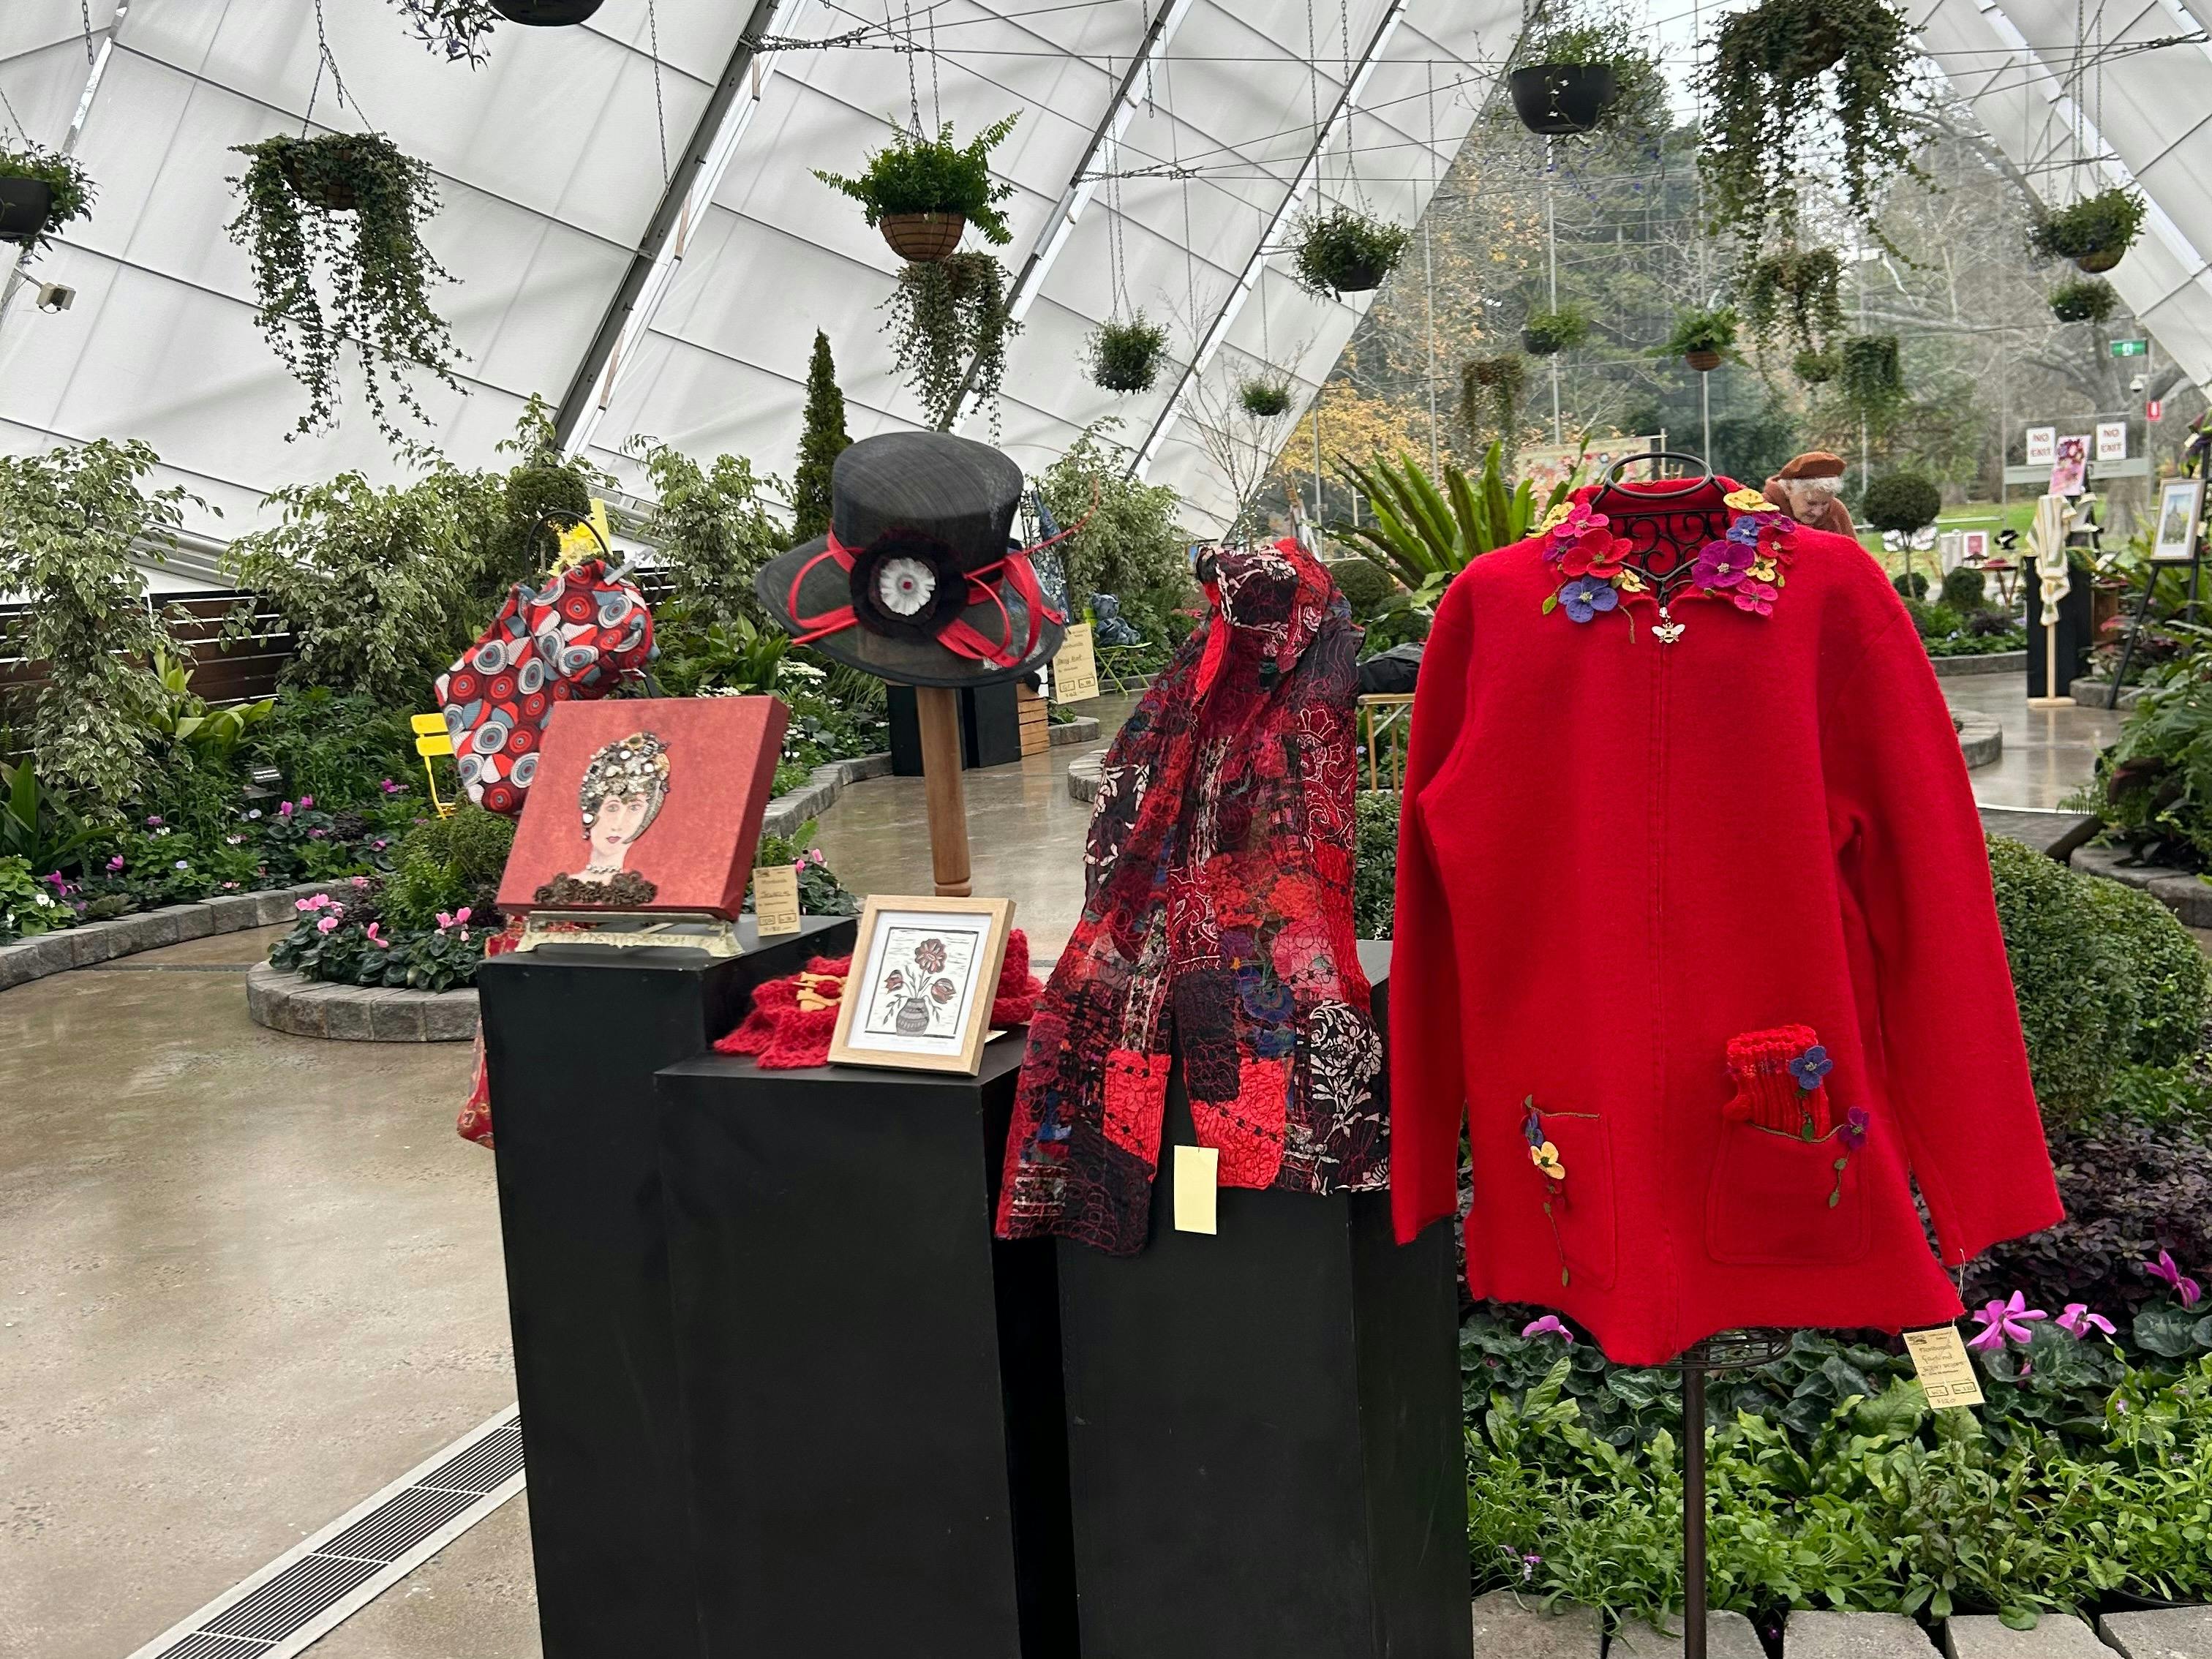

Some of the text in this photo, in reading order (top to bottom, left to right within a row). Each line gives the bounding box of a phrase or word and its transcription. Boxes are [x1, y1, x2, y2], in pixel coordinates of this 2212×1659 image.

[2033, 432, 2050, 442] NO
[2104, 428, 2120, 438] NO
[2100, 442, 2122, 453] EXIT
